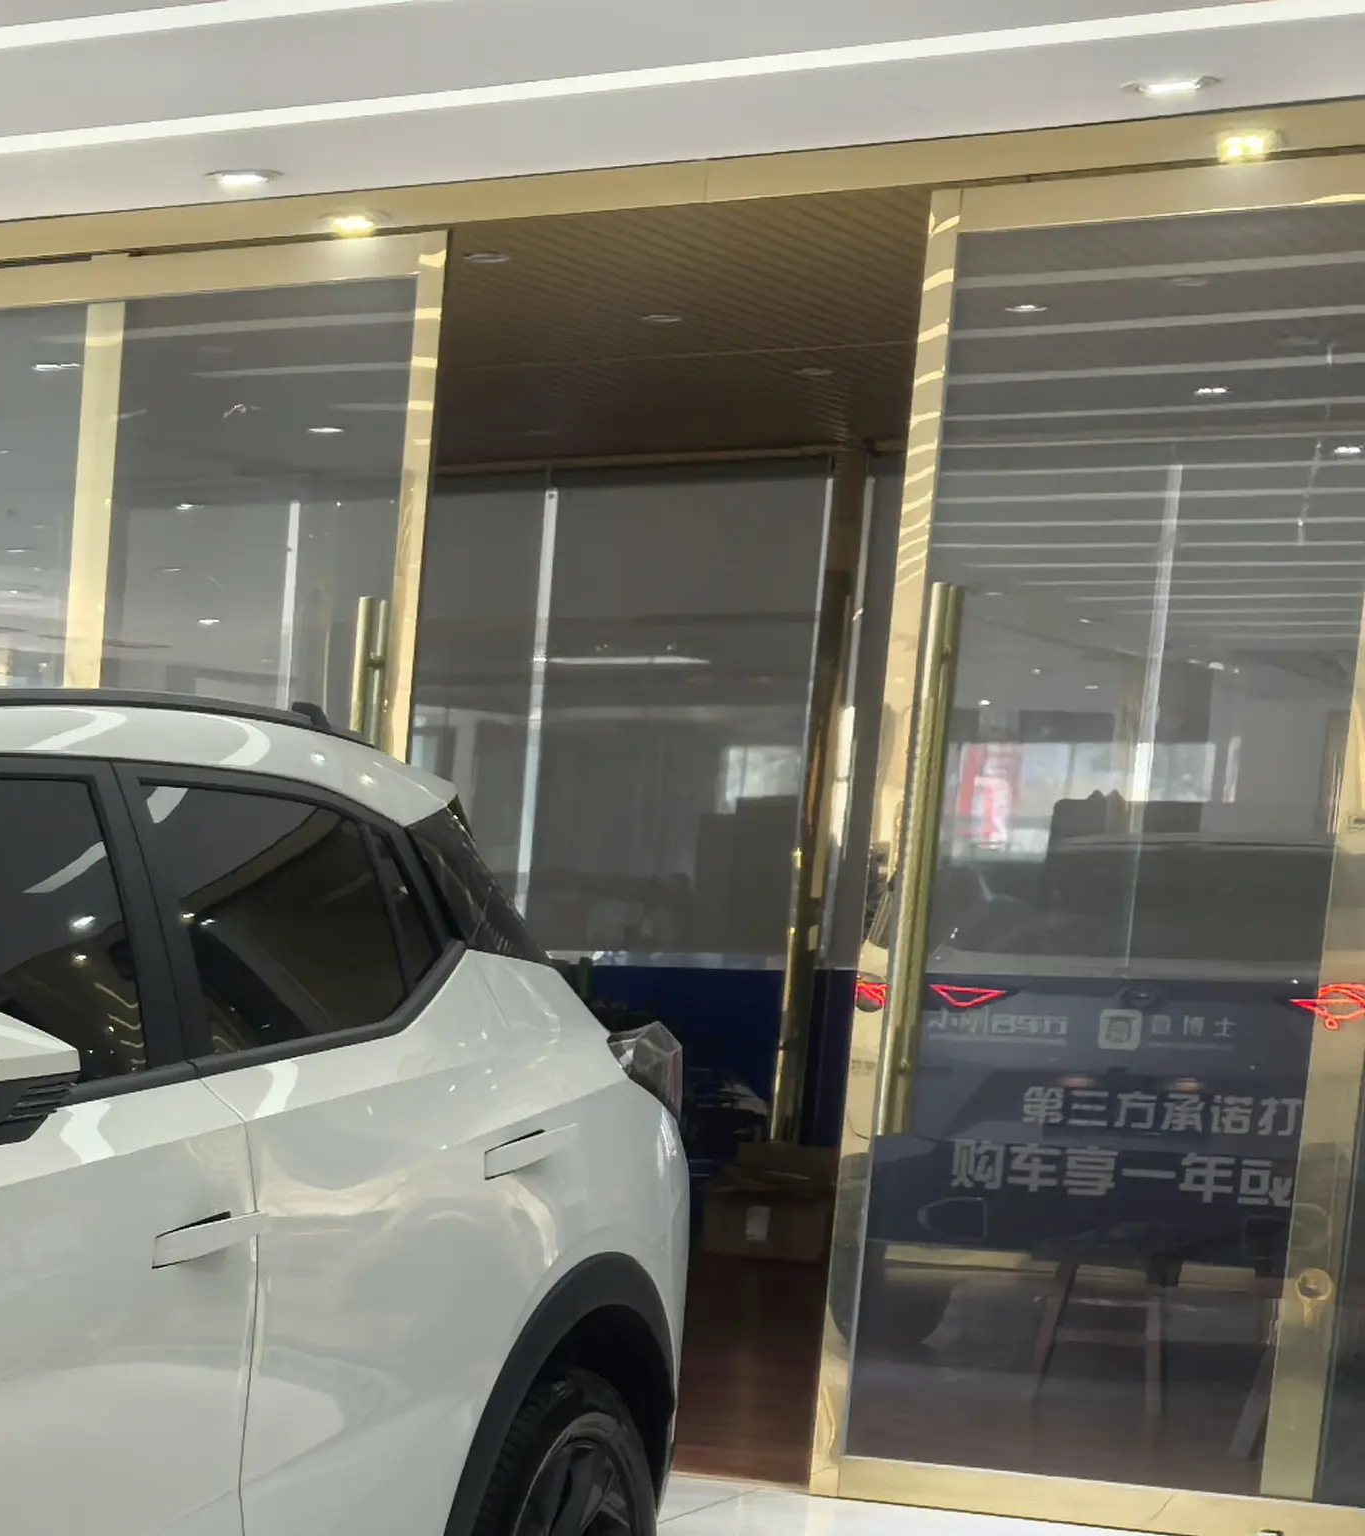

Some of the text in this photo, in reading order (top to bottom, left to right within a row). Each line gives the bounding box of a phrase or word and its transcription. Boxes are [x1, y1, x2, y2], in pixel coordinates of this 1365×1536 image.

[1022, 1086, 1303, 1136] 第三方承诺打
